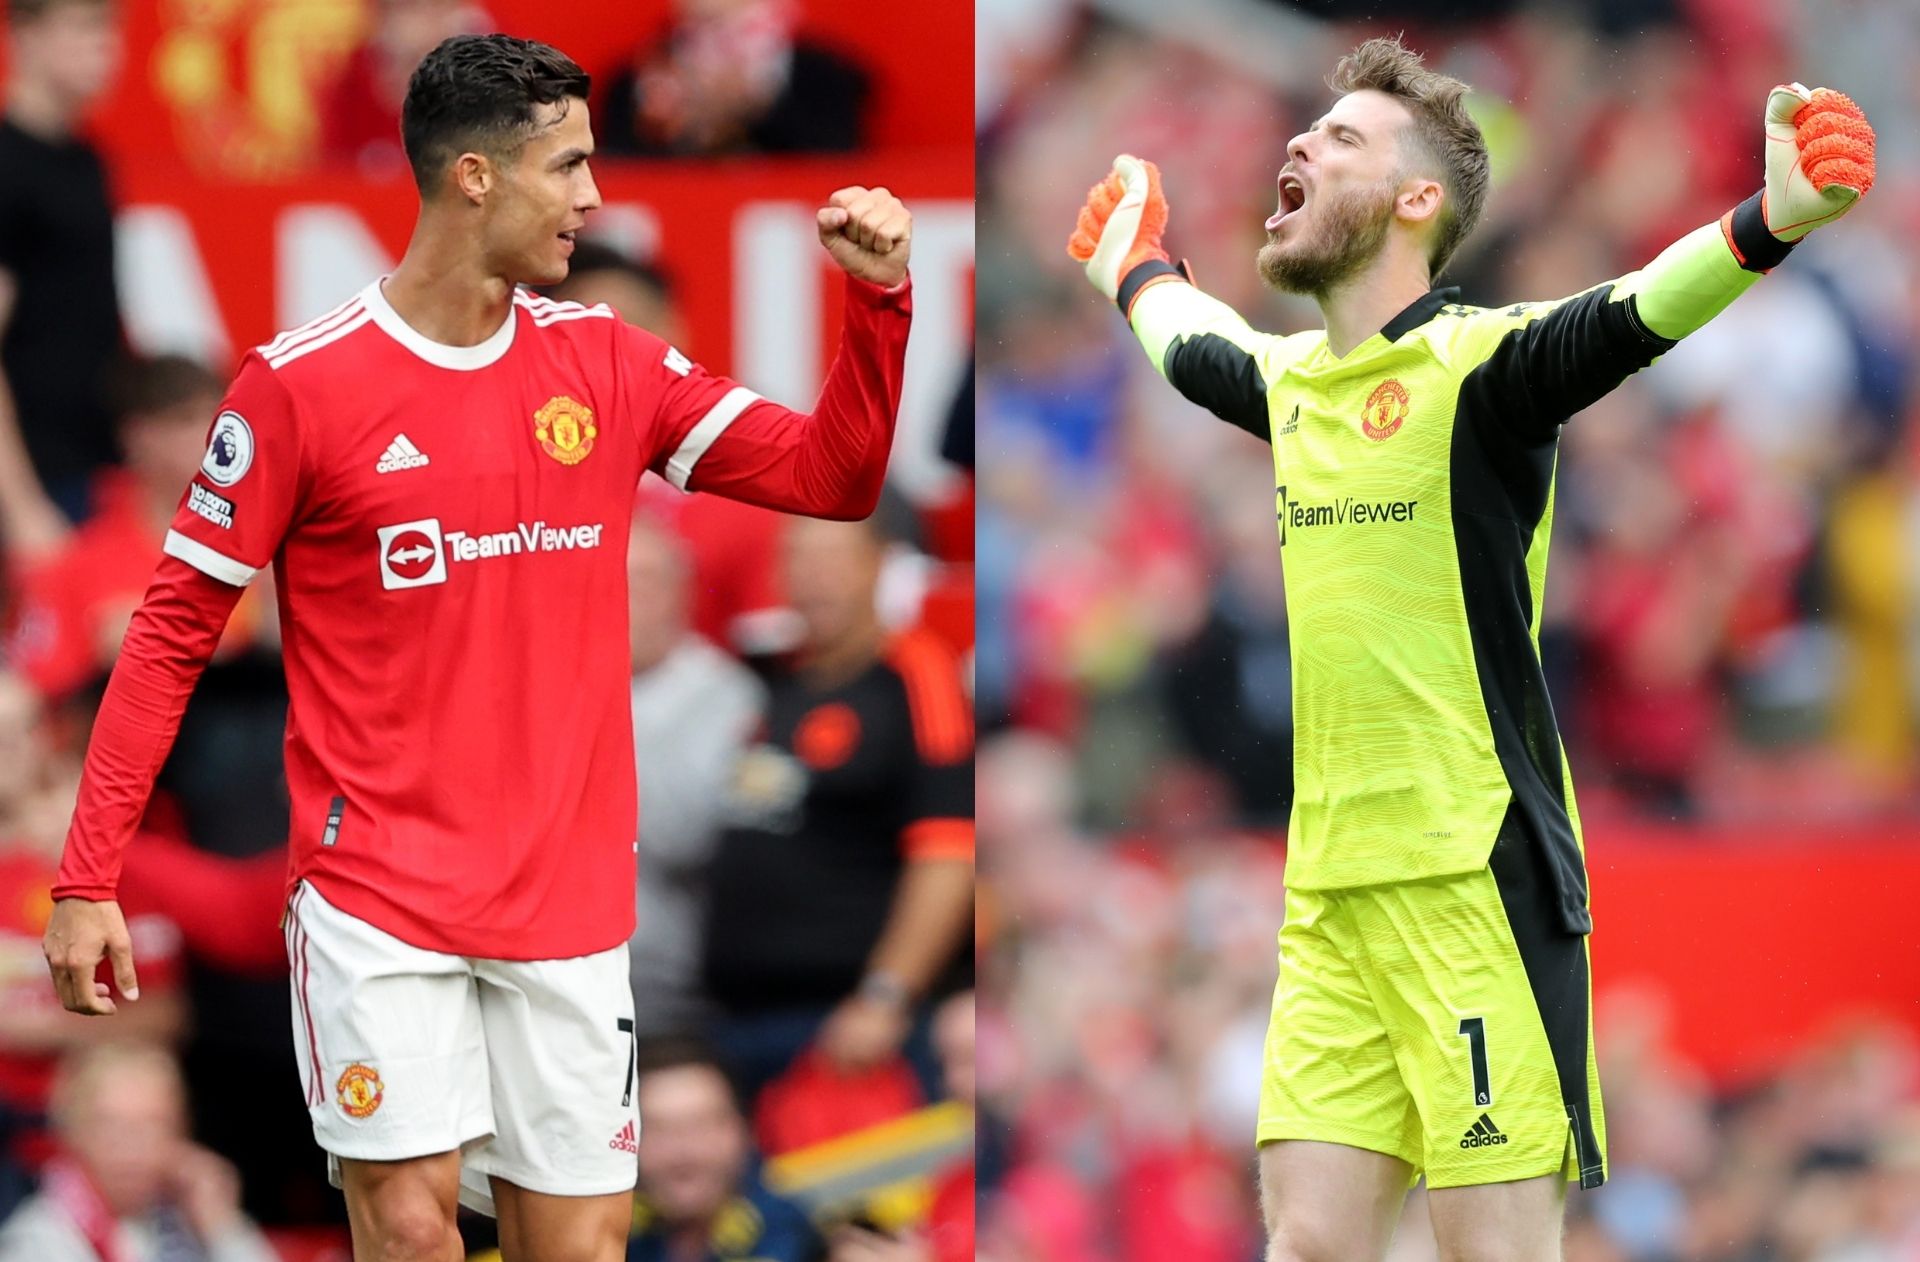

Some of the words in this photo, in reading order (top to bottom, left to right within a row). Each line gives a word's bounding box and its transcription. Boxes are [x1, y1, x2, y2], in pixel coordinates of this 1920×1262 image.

[376, 454, 430, 474] adidas
[1288, 497, 1418, 528] TeamViewer
[444, 521, 603, 562] TeamViewer
[617, 1017, 635, 1107] 7
[1458, 1016, 1492, 1106] 1
[1460, 1133, 1508, 1149] adidas
